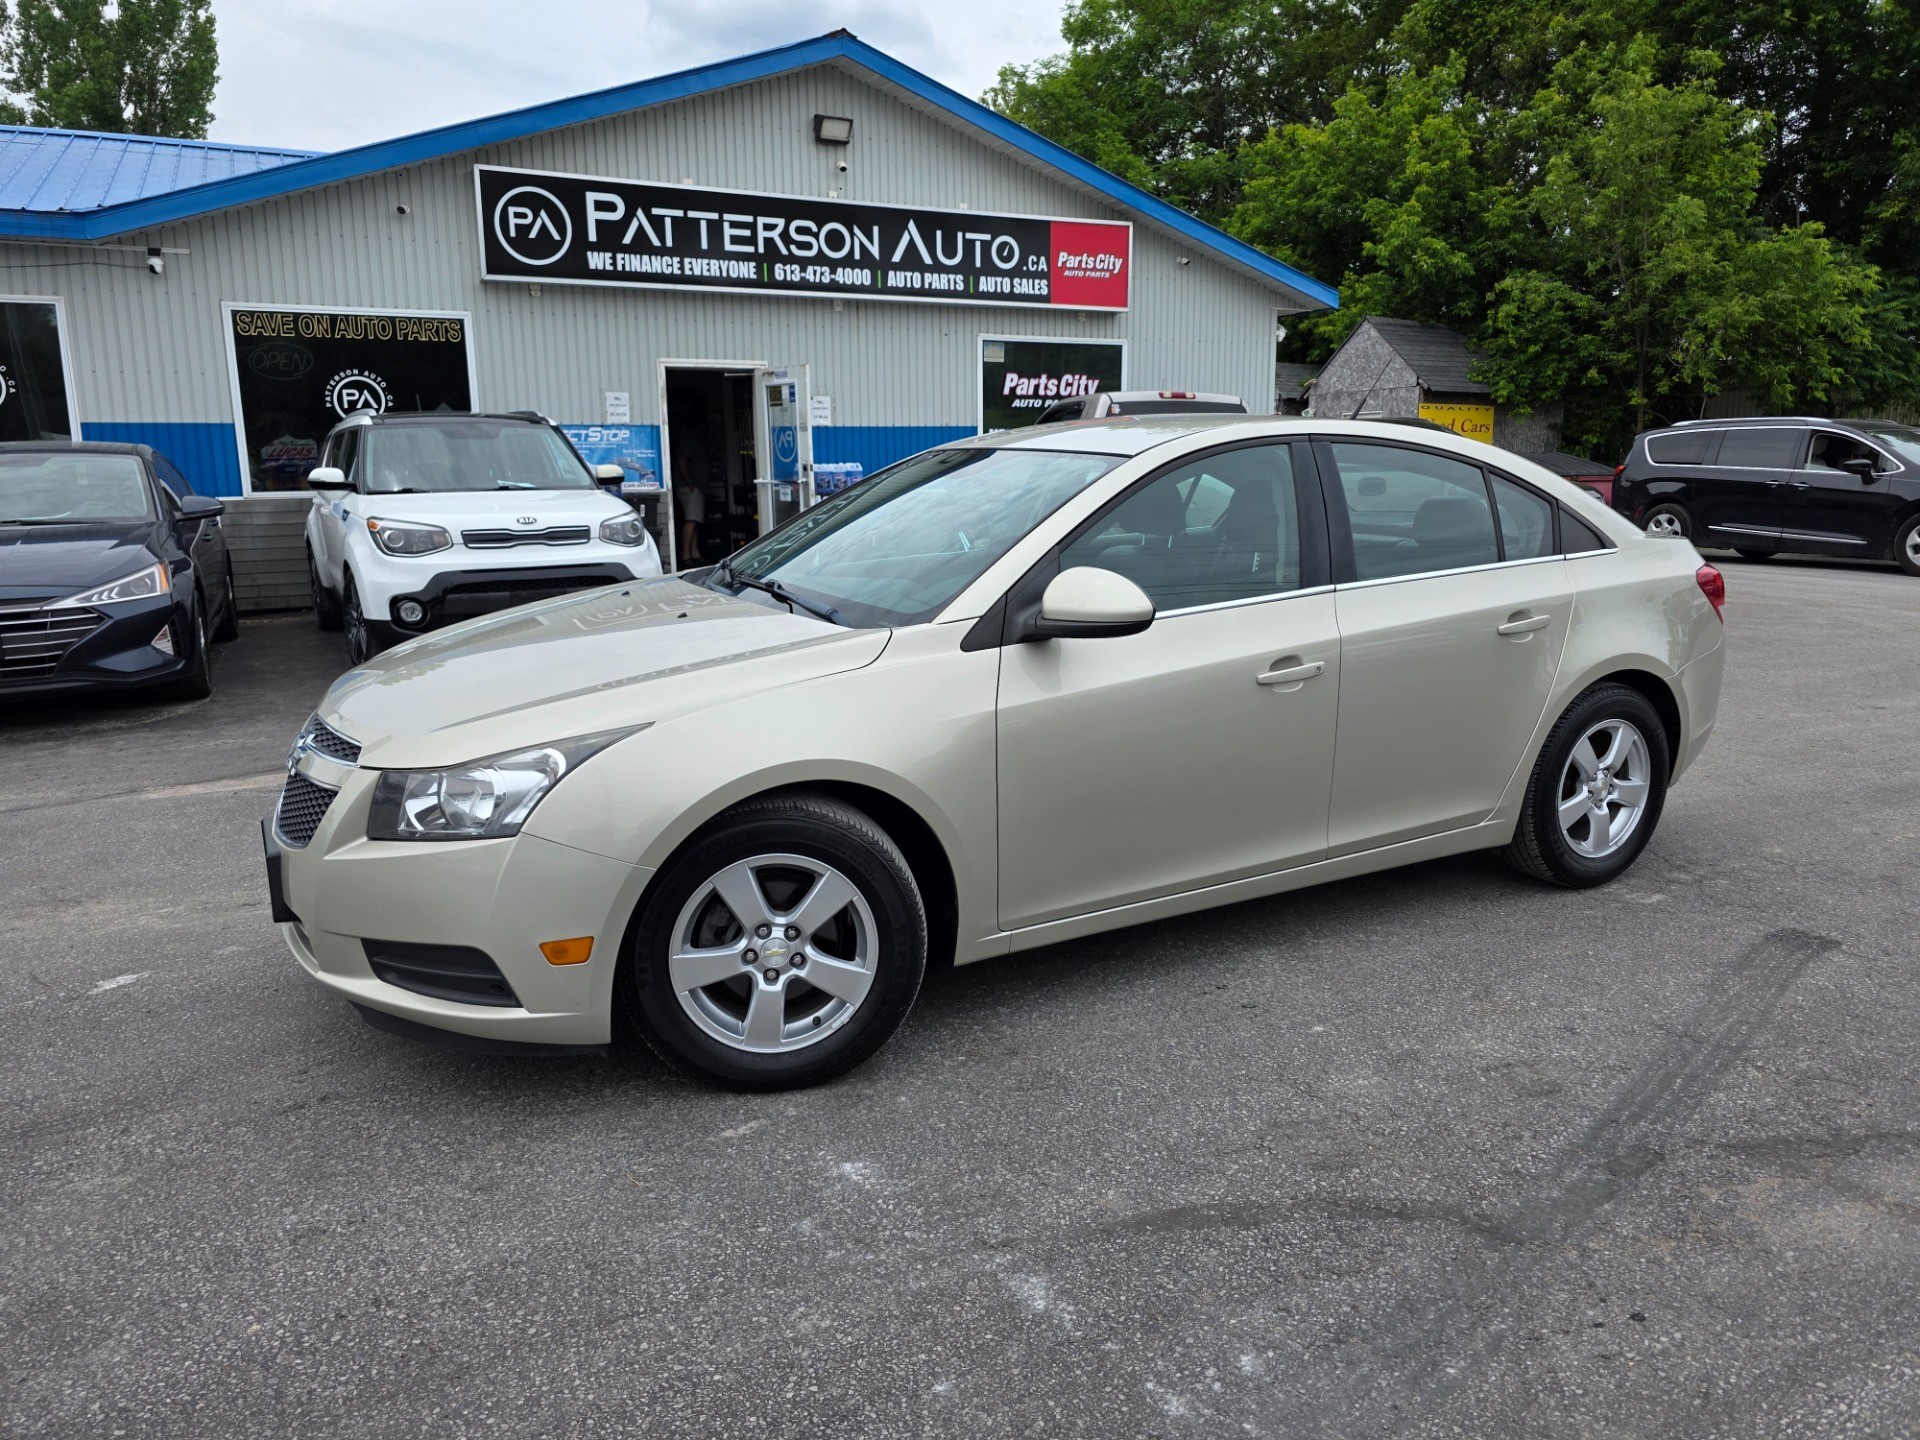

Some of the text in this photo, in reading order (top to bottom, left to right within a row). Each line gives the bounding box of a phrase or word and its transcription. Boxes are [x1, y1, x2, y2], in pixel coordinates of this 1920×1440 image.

[507, 206, 561, 240] PA
[585, 191, 880, 261] PATTERSON
[891, 218, 1020, 270] AUTO
[587, 251, 1048, 295] WE FINANCE EVERYONE 613-473-4000 AUTO PARTS AUTO SALES
[237, 312, 462, 342] SAVE ON AUTO PARTS
[252, 351, 307, 371] OPEN
[325, 368, 359, 408] PATTERSON
[363, 370, 387, 388] AUTO
[342, 389, 379, 409] PA
[1011, 399, 1042, 408] AUTO
[1461, 418, 1491, 433] Cars
[267, 446, 314, 458] LUCAS
[519, 516, 536, 525] KIA
